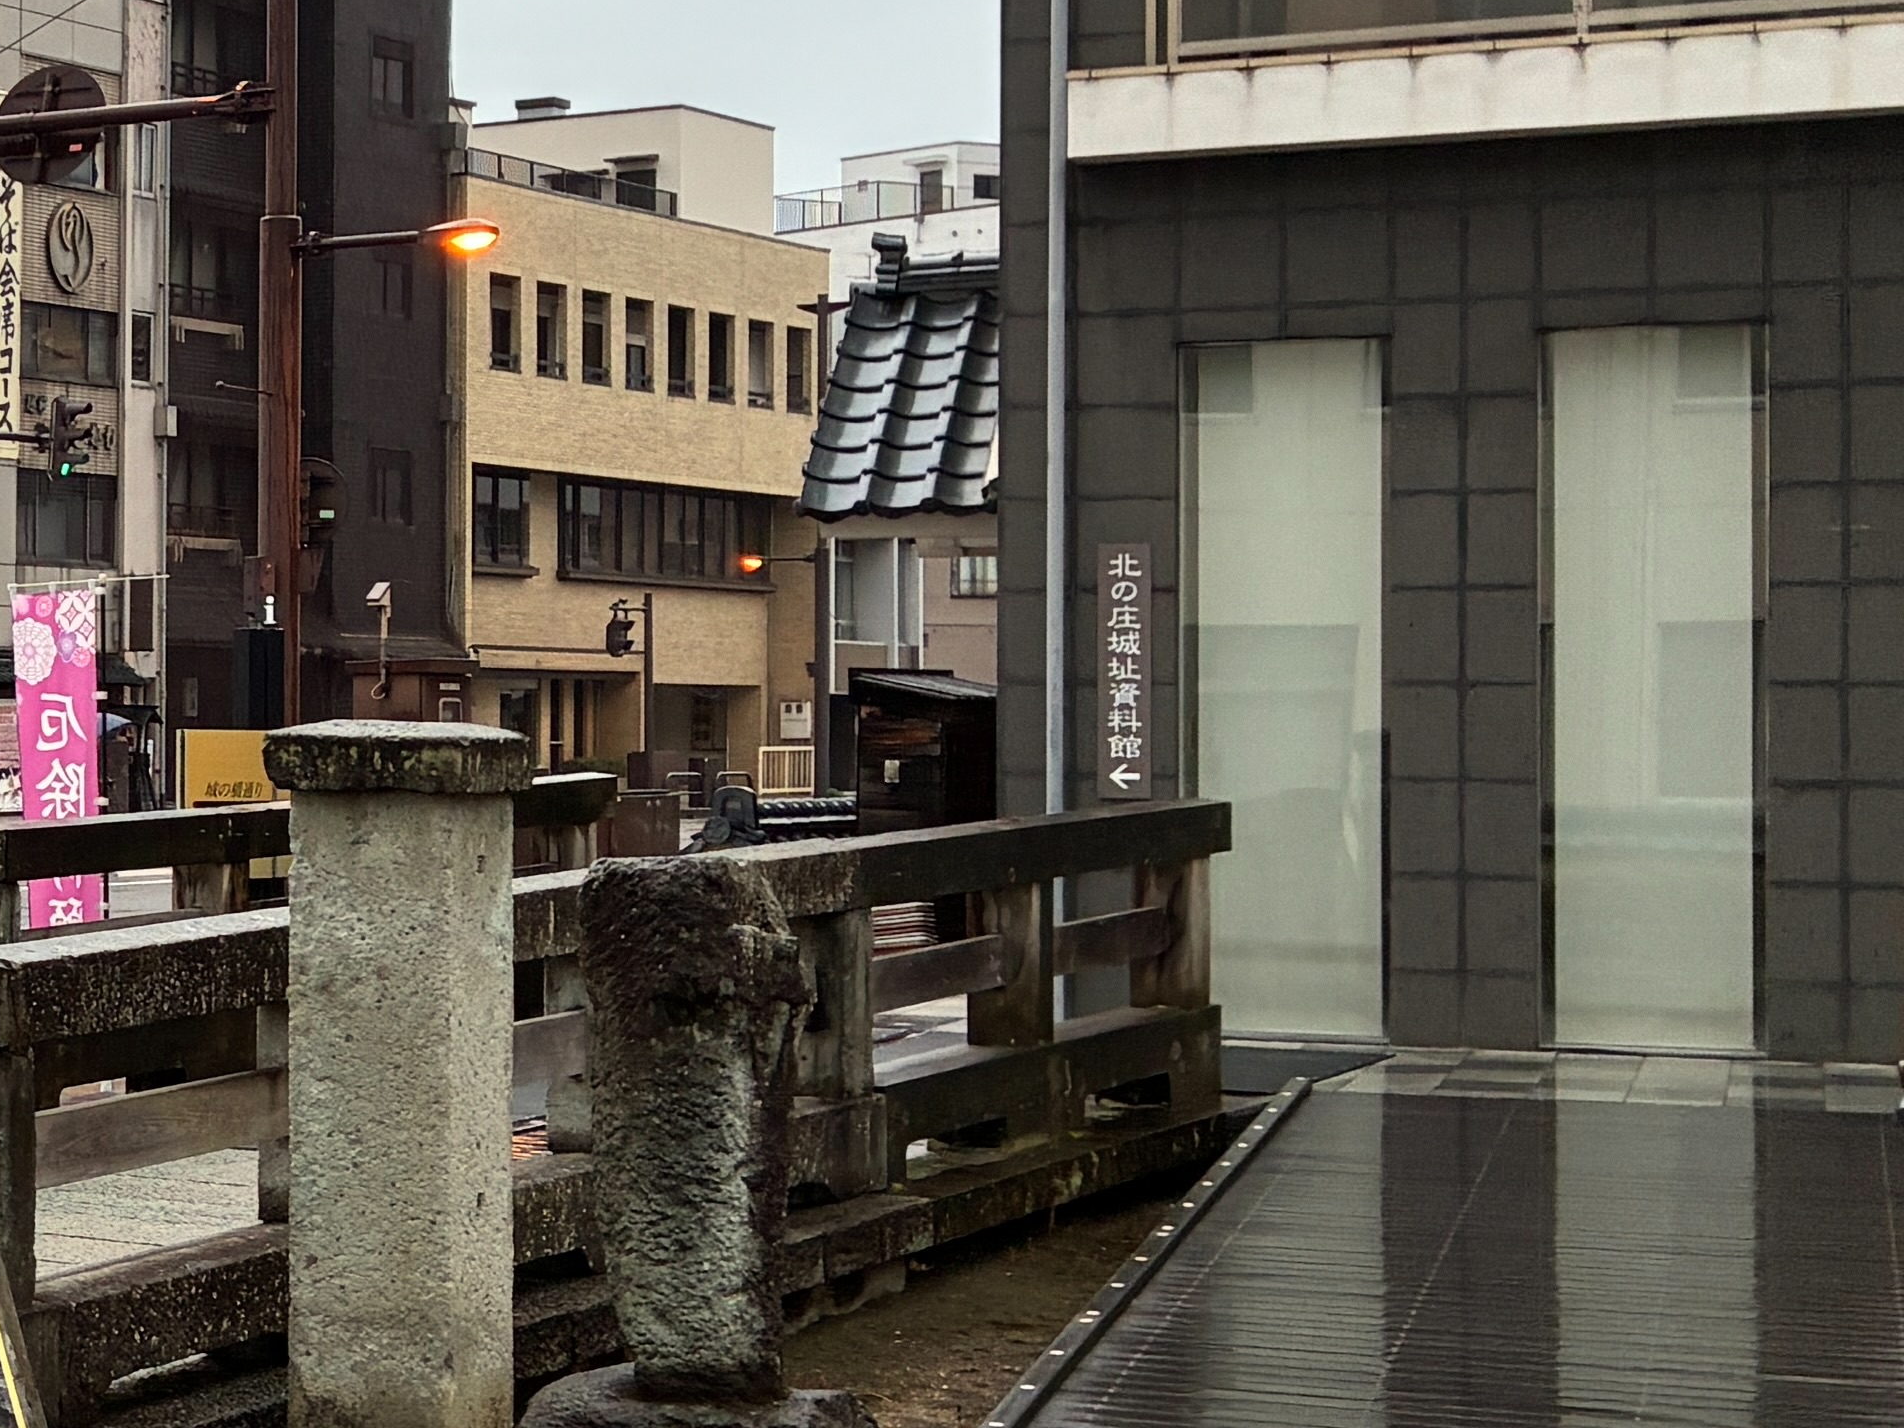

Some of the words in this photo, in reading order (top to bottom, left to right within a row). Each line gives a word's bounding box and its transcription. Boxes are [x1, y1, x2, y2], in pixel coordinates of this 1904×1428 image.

[1107, 553, 1142, 759] 北の庄城址資料館
